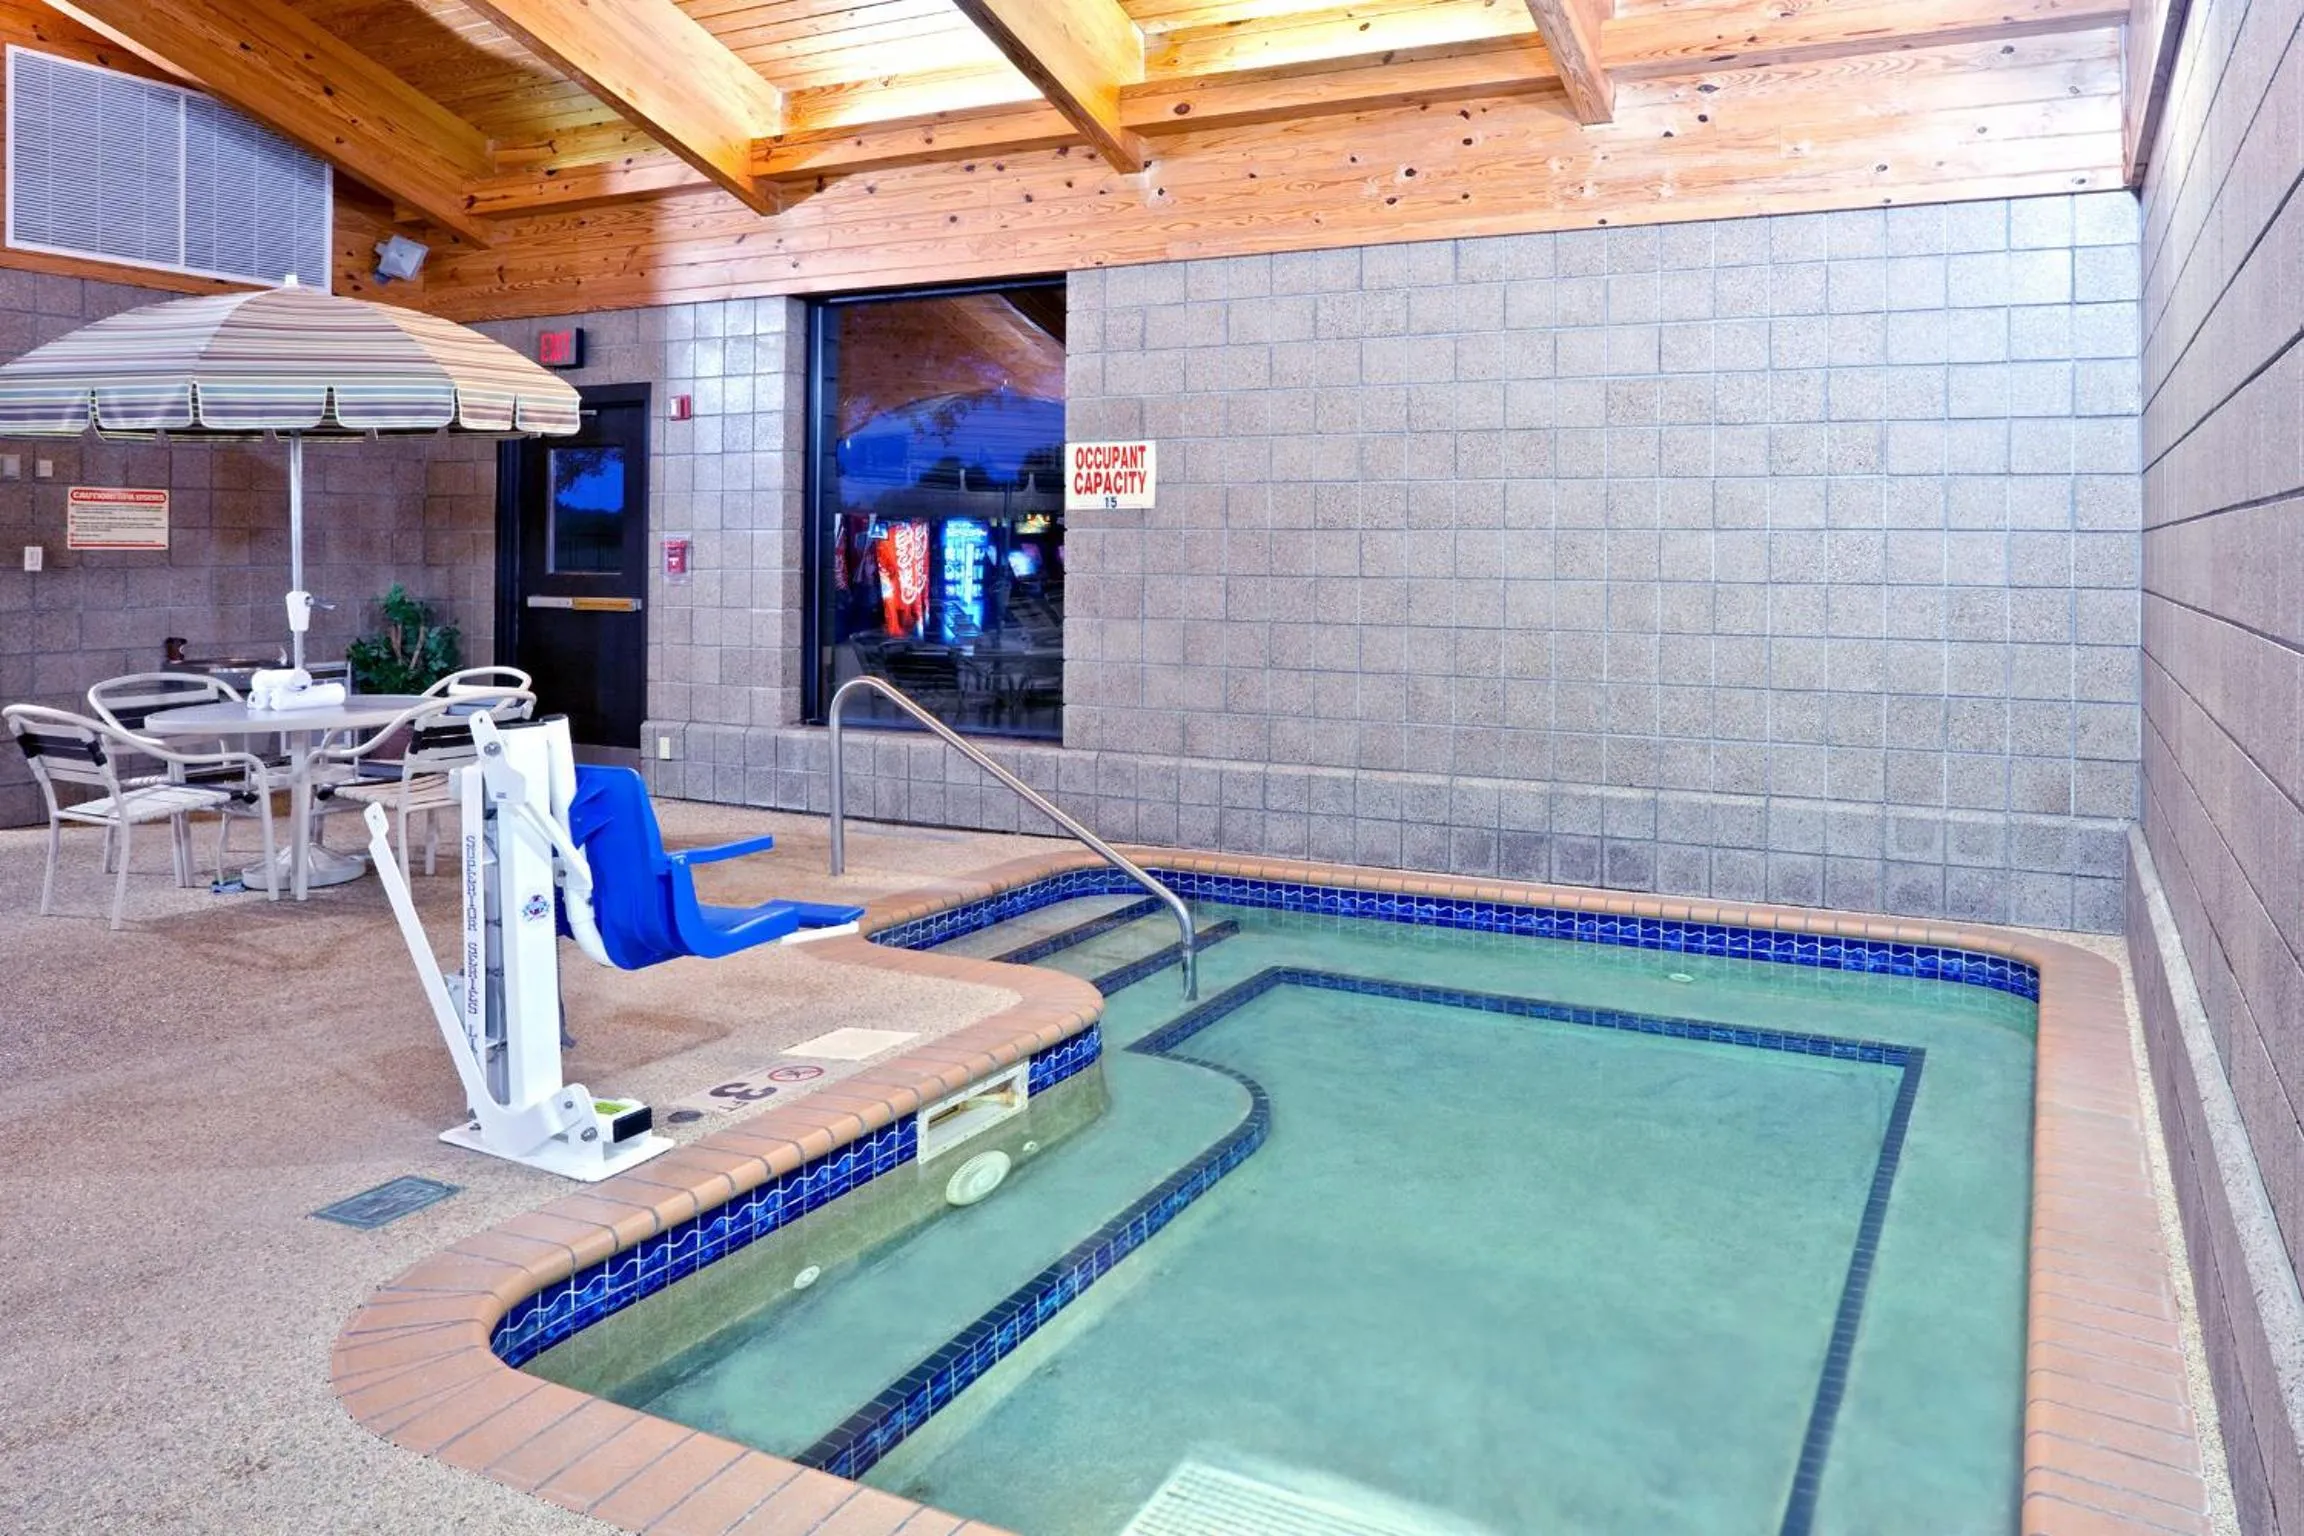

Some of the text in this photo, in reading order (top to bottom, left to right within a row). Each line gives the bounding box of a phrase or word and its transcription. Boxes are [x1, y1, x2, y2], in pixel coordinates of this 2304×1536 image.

[540, 331, 571, 362] EXIT
[1075, 445, 1147, 469] OCCUPANT
[1074, 471, 1147, 495] CAPACITY
[1104, 496, 1118, 508] 15
